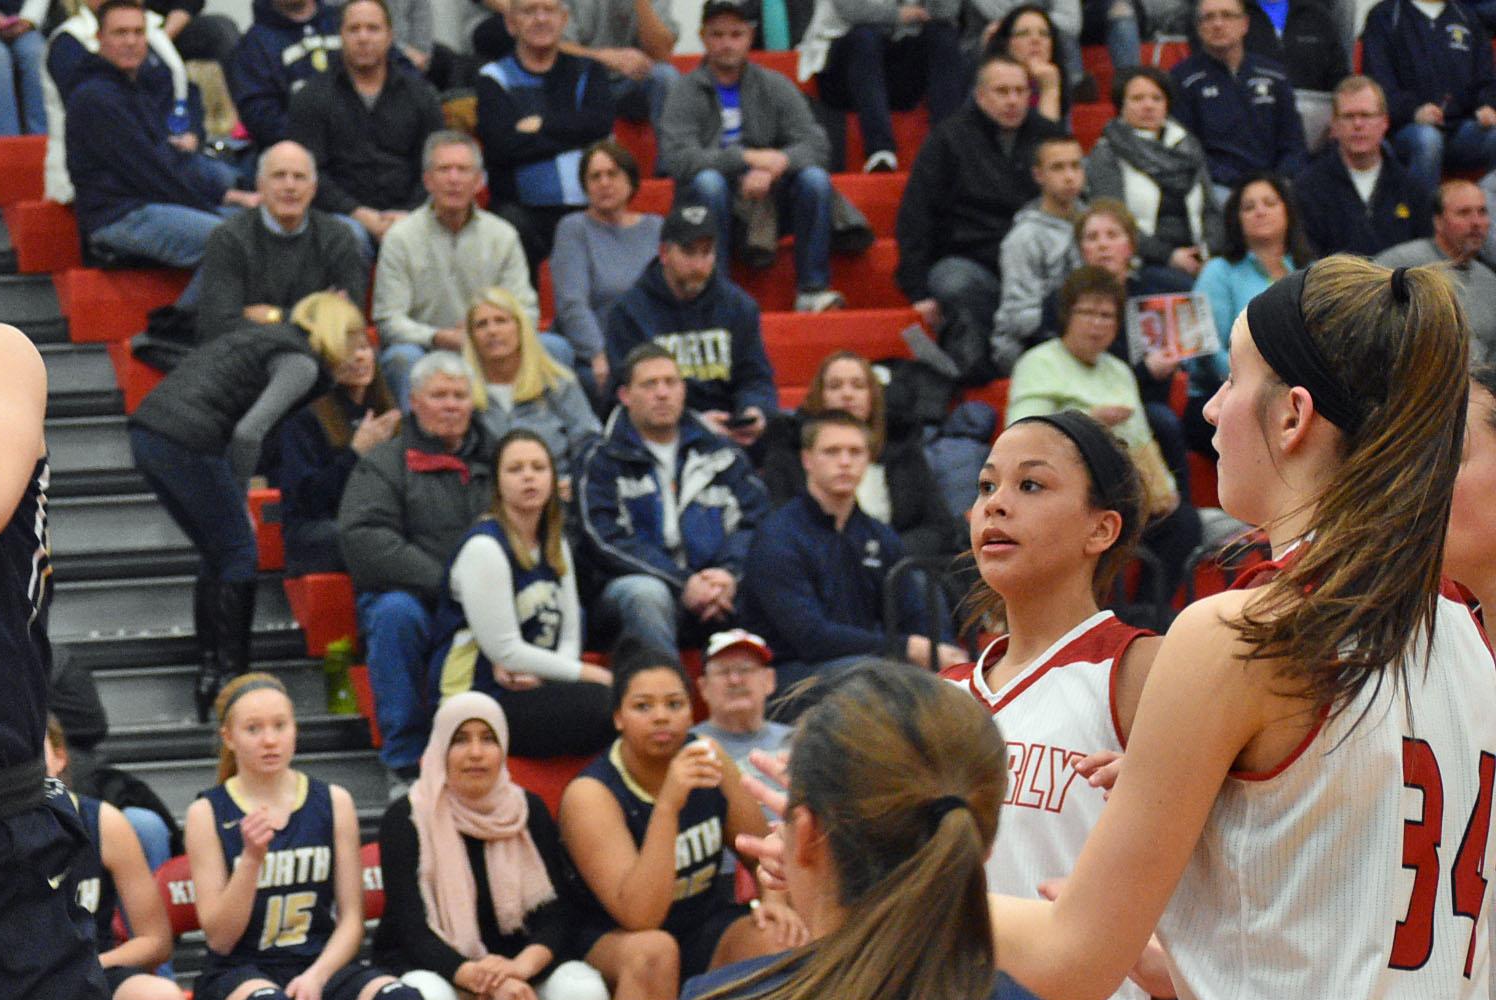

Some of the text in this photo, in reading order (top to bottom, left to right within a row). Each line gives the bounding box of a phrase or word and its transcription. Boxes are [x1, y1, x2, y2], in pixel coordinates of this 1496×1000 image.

[653, 327, 731, 367] ORTH
[233, 846, 331, 890] ORTH
[1388, 735, 1496, 980] 34
[258, 890, 318, 951] 15
